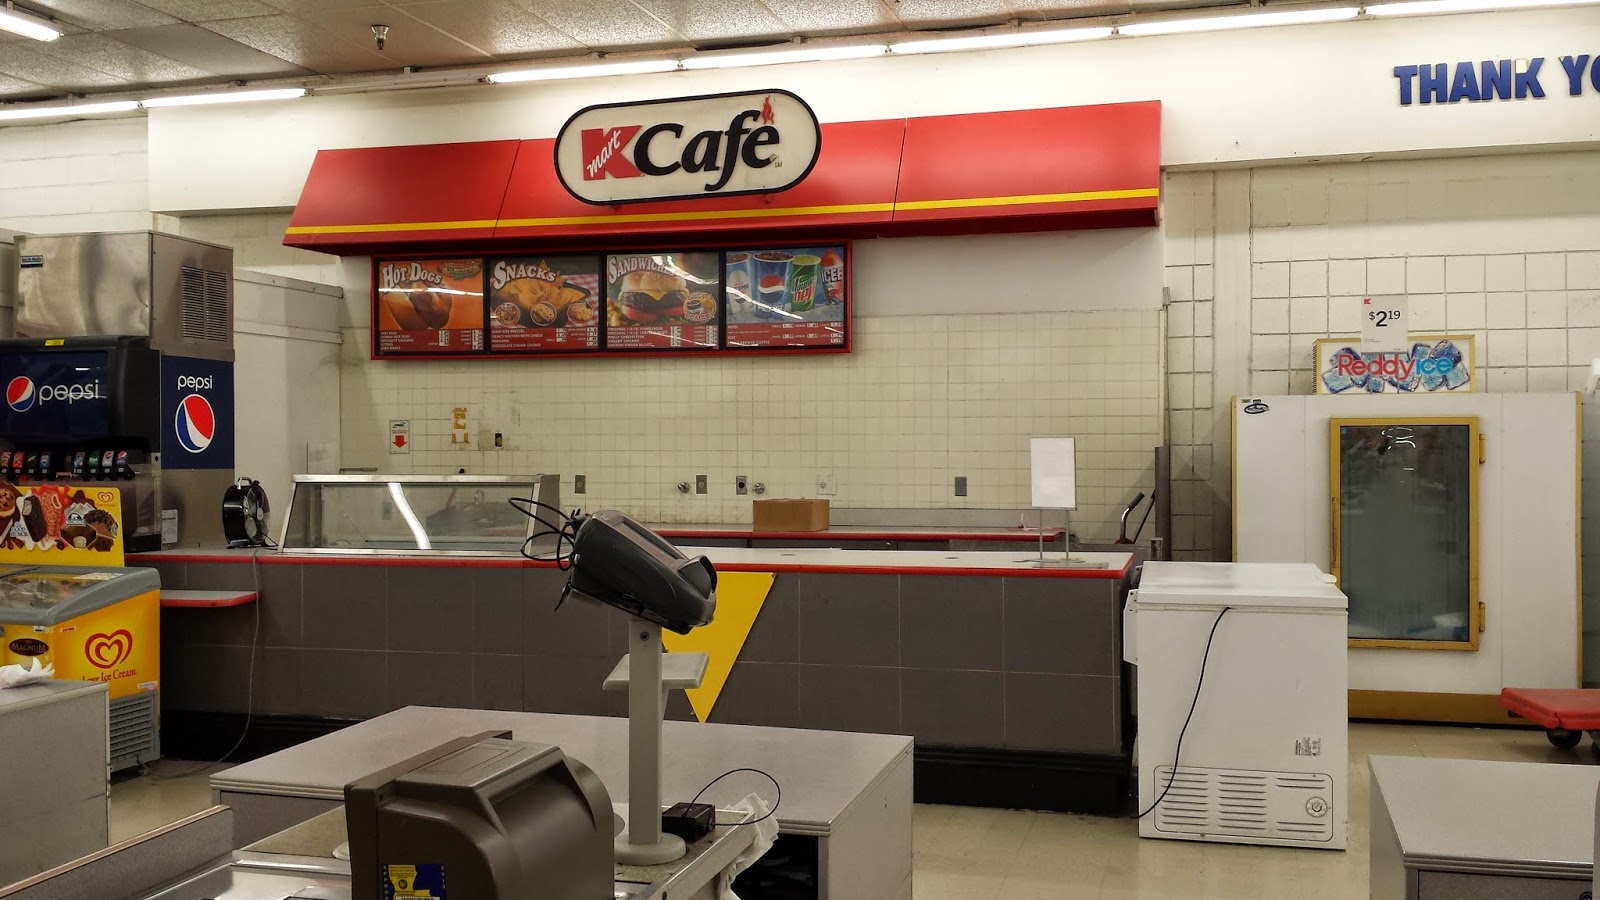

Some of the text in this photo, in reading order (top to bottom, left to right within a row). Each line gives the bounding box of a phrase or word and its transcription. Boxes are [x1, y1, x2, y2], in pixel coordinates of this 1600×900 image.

[1394, 57, 1545, 104] THANK
[382, 263, 407, 293] HOT
[409, 262, 442, 284] DOGS
[493, 261, 556, 290] SNACKS
[820, 267, 842, 283] ICEE
[39, 379, 99, 405] pepsi
[177, 374, 213, 392] pepsi
[101, 672, 112, 682] Ice
[112, 667, 136, 680] Cream
